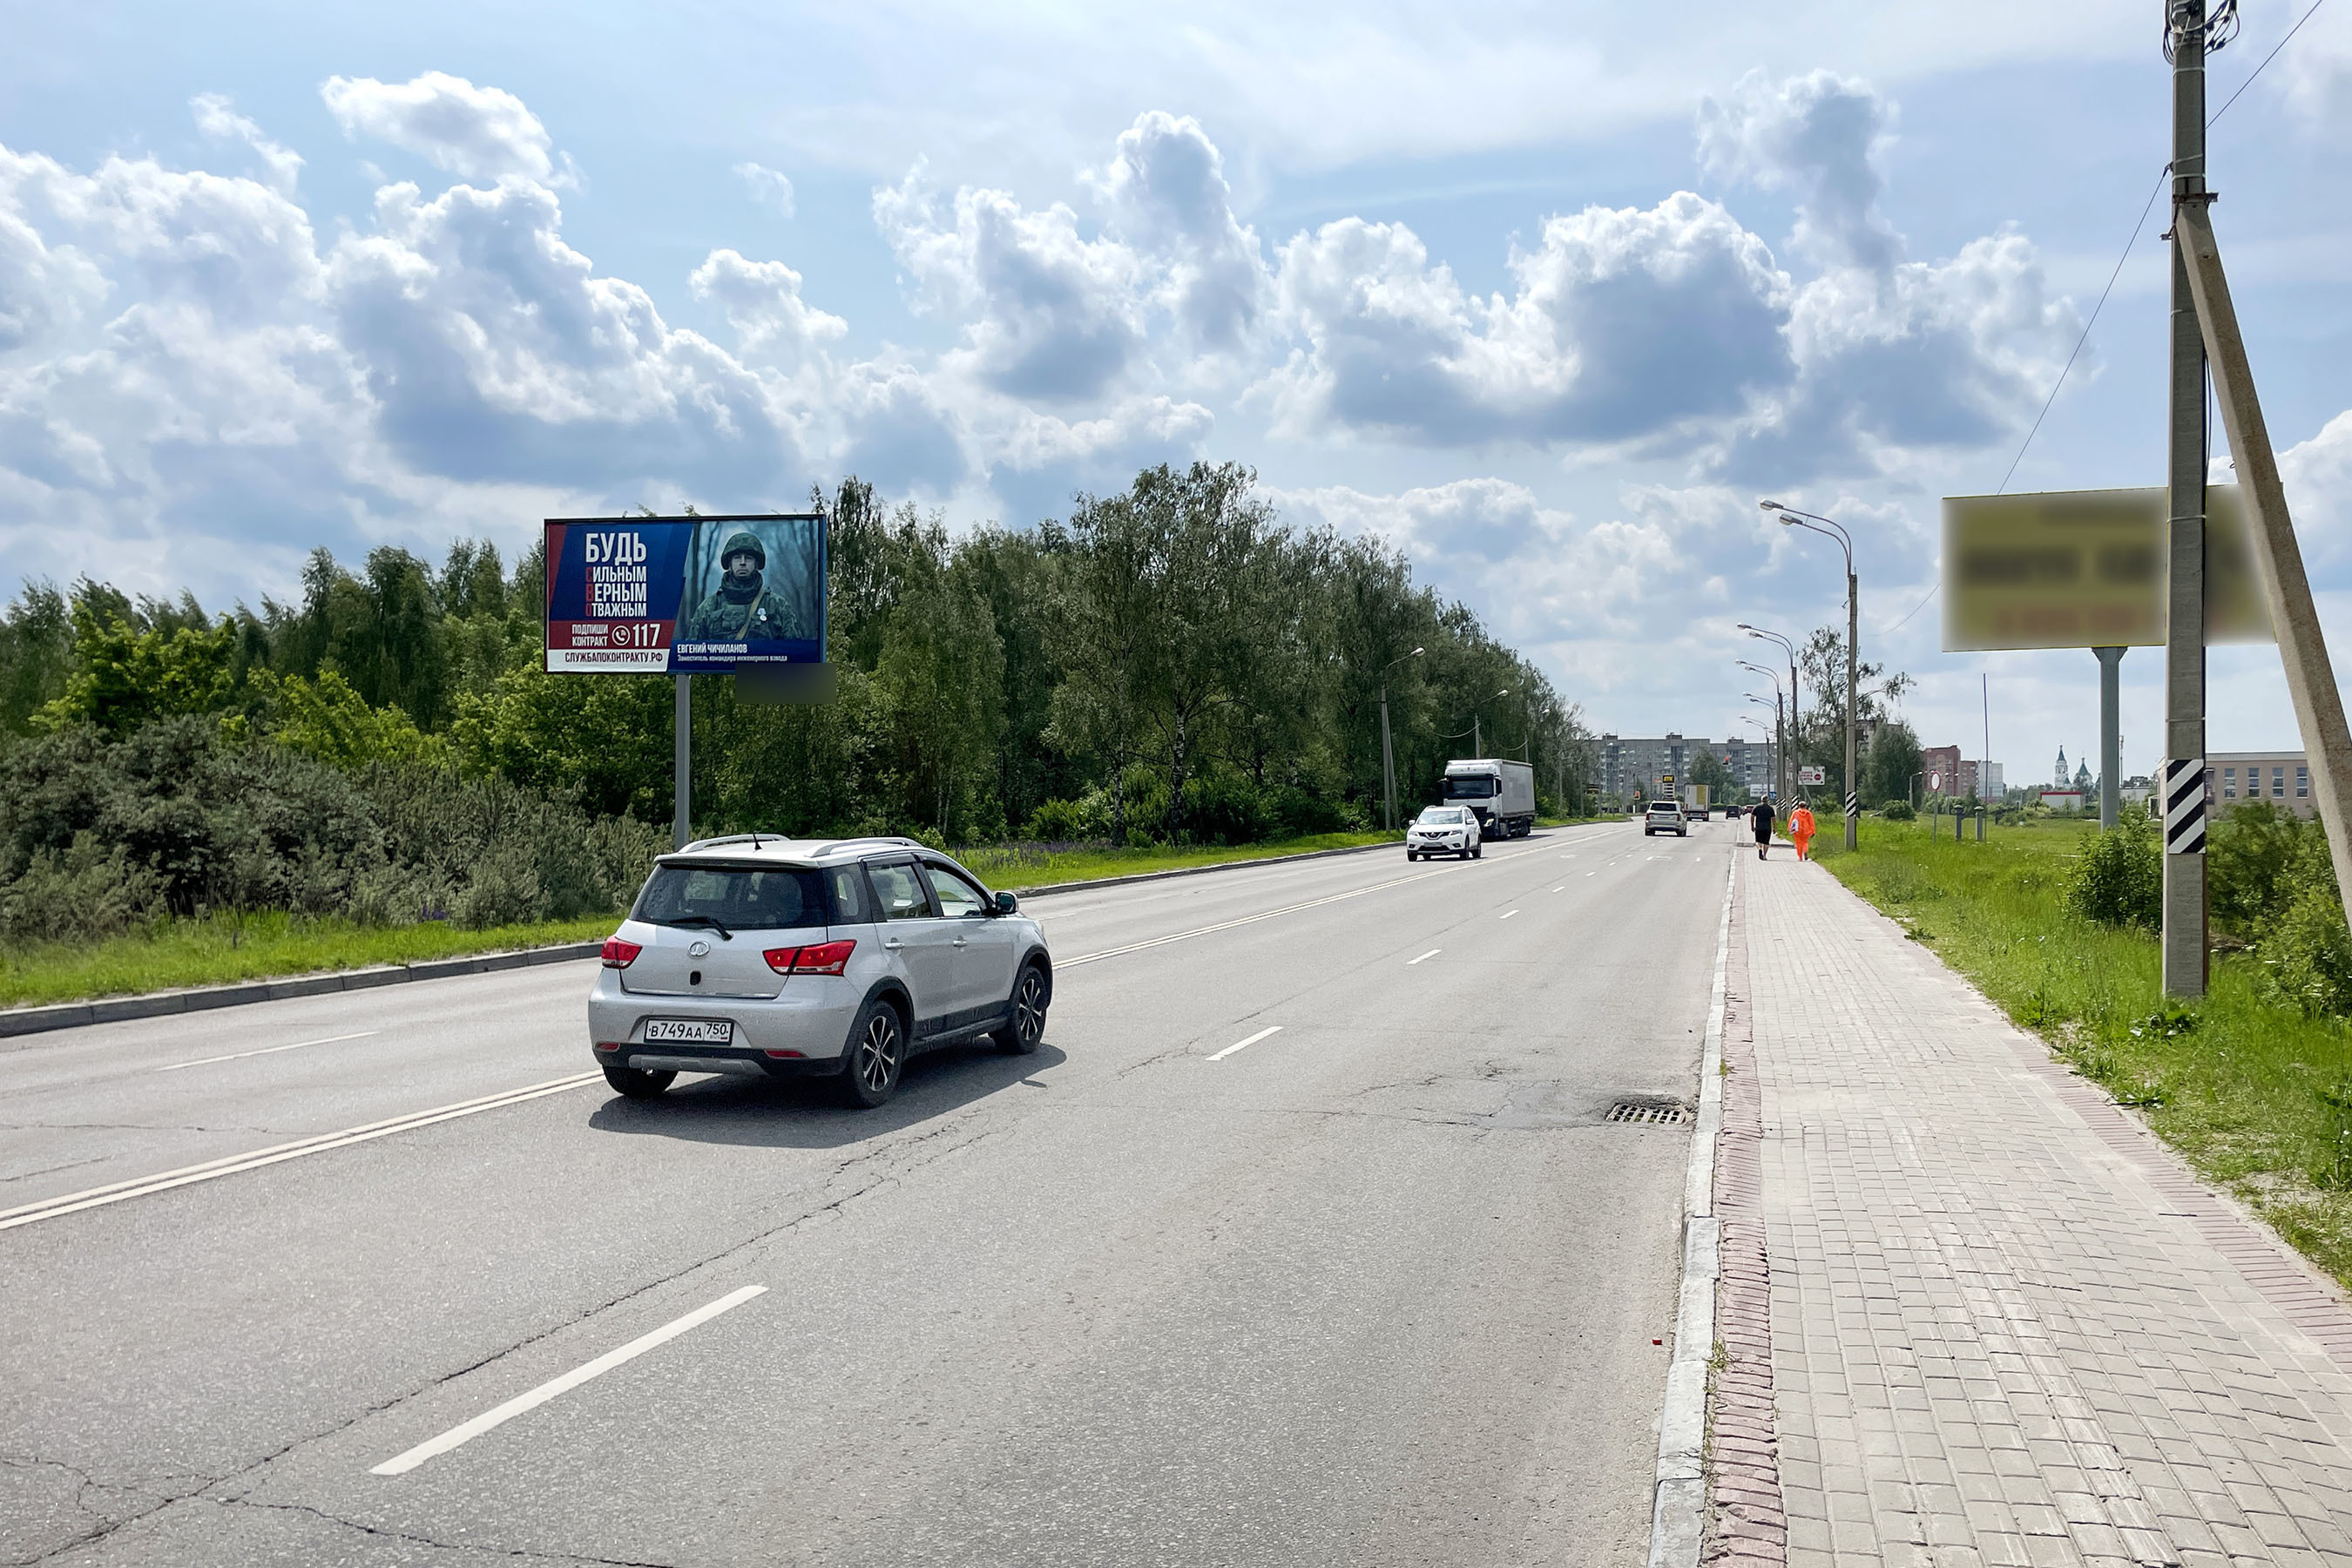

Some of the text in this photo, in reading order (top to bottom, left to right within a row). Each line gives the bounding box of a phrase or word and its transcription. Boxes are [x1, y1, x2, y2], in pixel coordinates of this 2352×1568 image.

[585, 532, 647, 566] БУДЬ
[585, 565, 647, 583] СИЛЬНЫМ
[585, 582, 647, 602] ВЕРНЫМ
[585, 602, 647, 618] ОТВАЖНЫМ
[571, 624, 609, 636] ПОДПИШИ
[632, 623, 661, 647] 117
[571, 636, 609, 647] КОНТРАКТ
[677, 642, 706, 654] ЕВГЕНИЙ
[564, 652, 664, 663] СЛУЖБАПОКОНТРАКТУ.РФ
